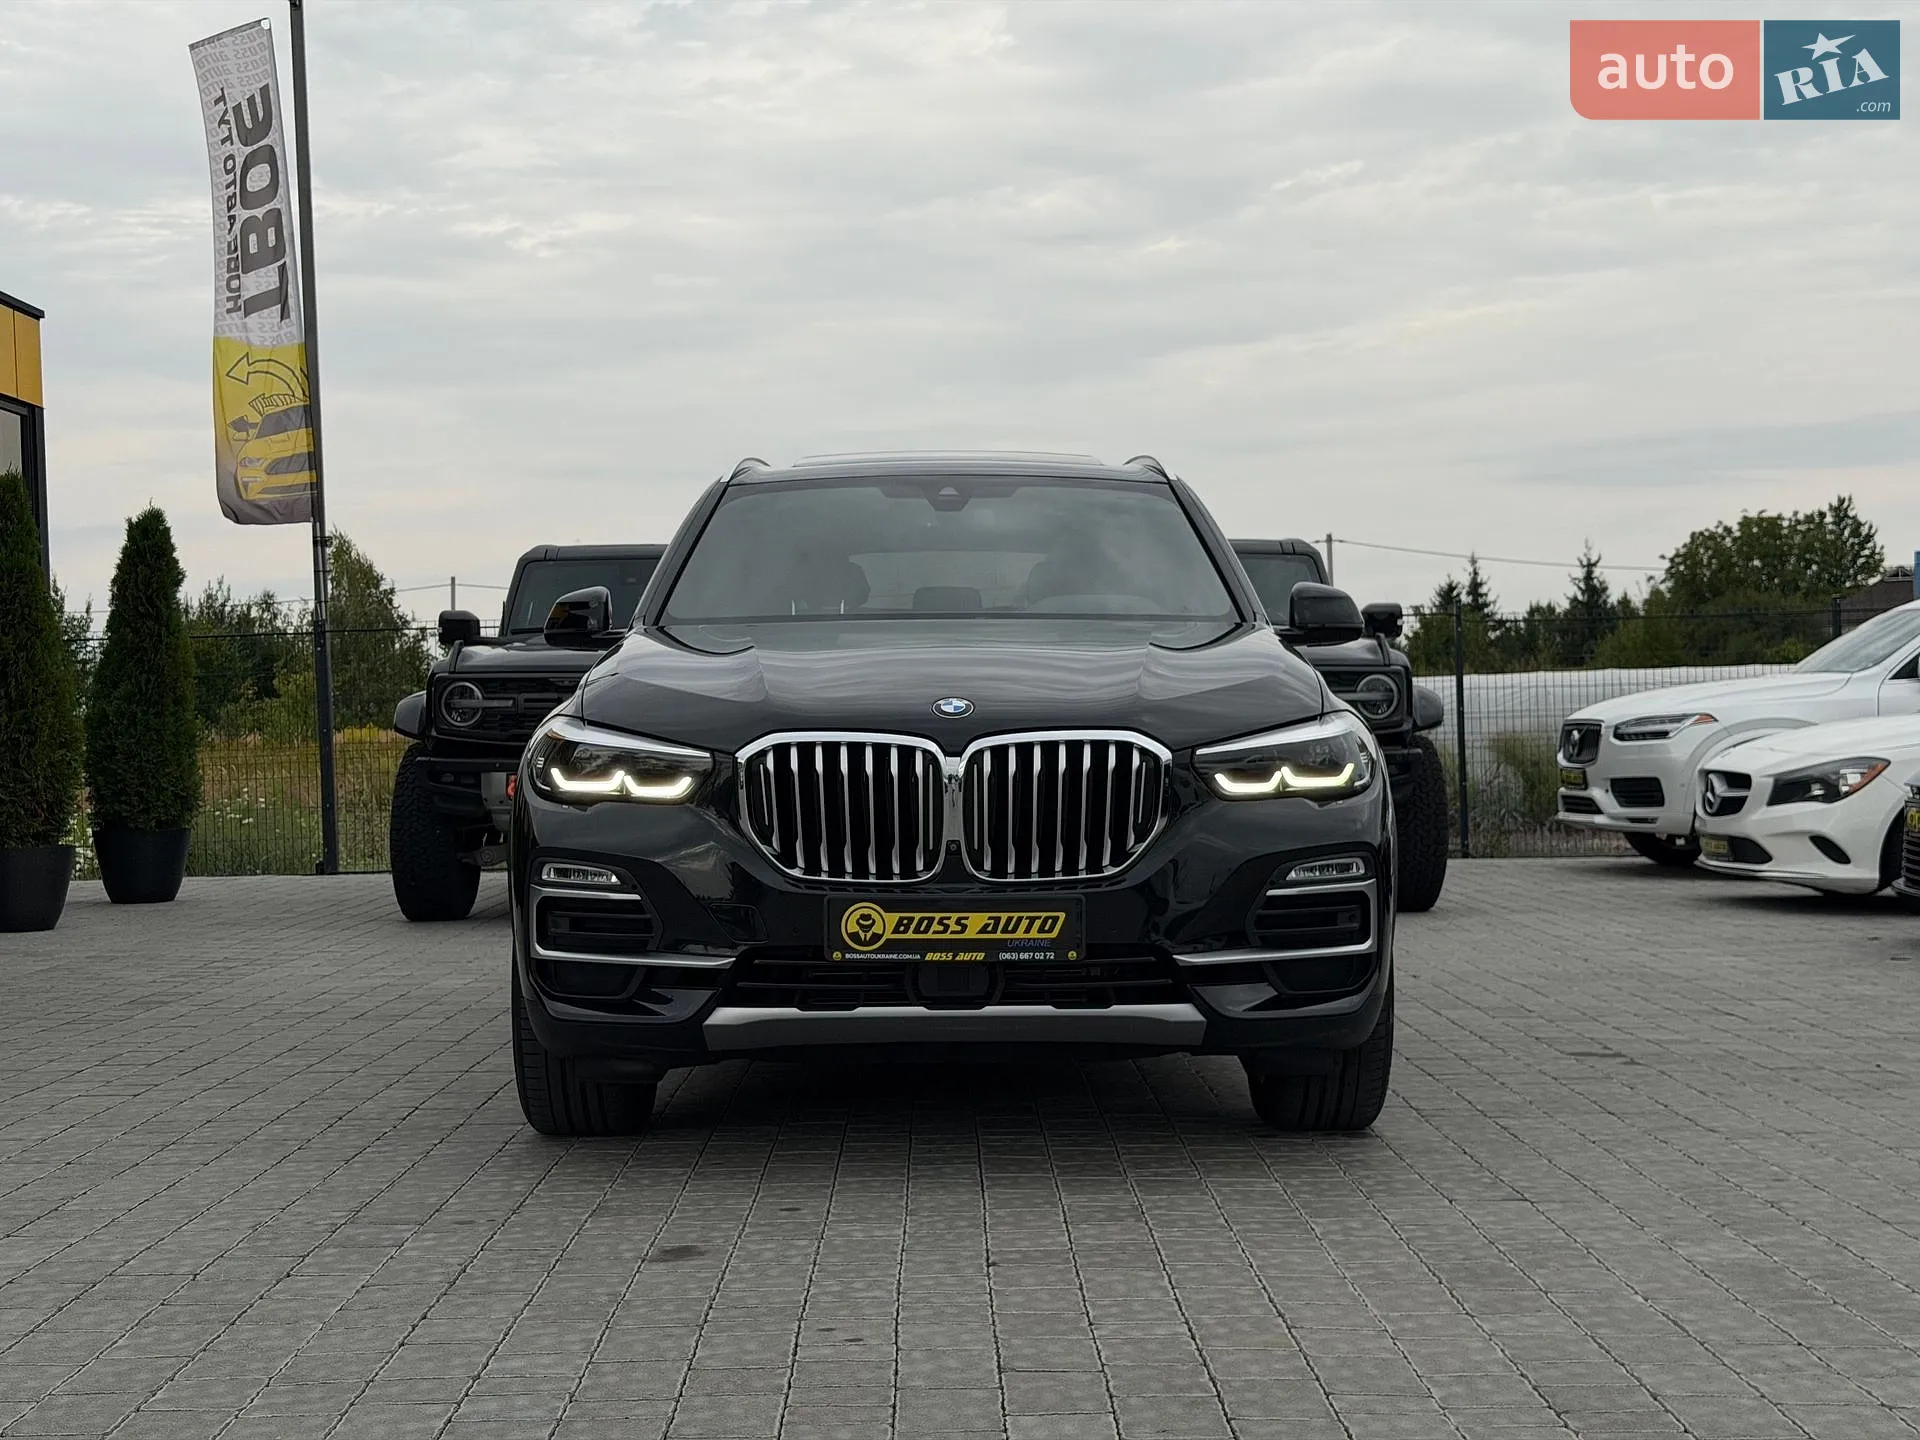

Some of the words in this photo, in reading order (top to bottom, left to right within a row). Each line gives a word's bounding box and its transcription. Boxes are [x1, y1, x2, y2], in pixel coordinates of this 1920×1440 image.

[890, 915, 971, 935] BOSS
[976, 915, 1060, 934] AUTO
[1007, 939, 1051, 947] UKRAINE
[924, 952, 953, 961] BOSS
[955, 952, 985, 961] AUTO
[1034, 952, 1045, 960] 02
[1045, 952, 1055, 960] 72
